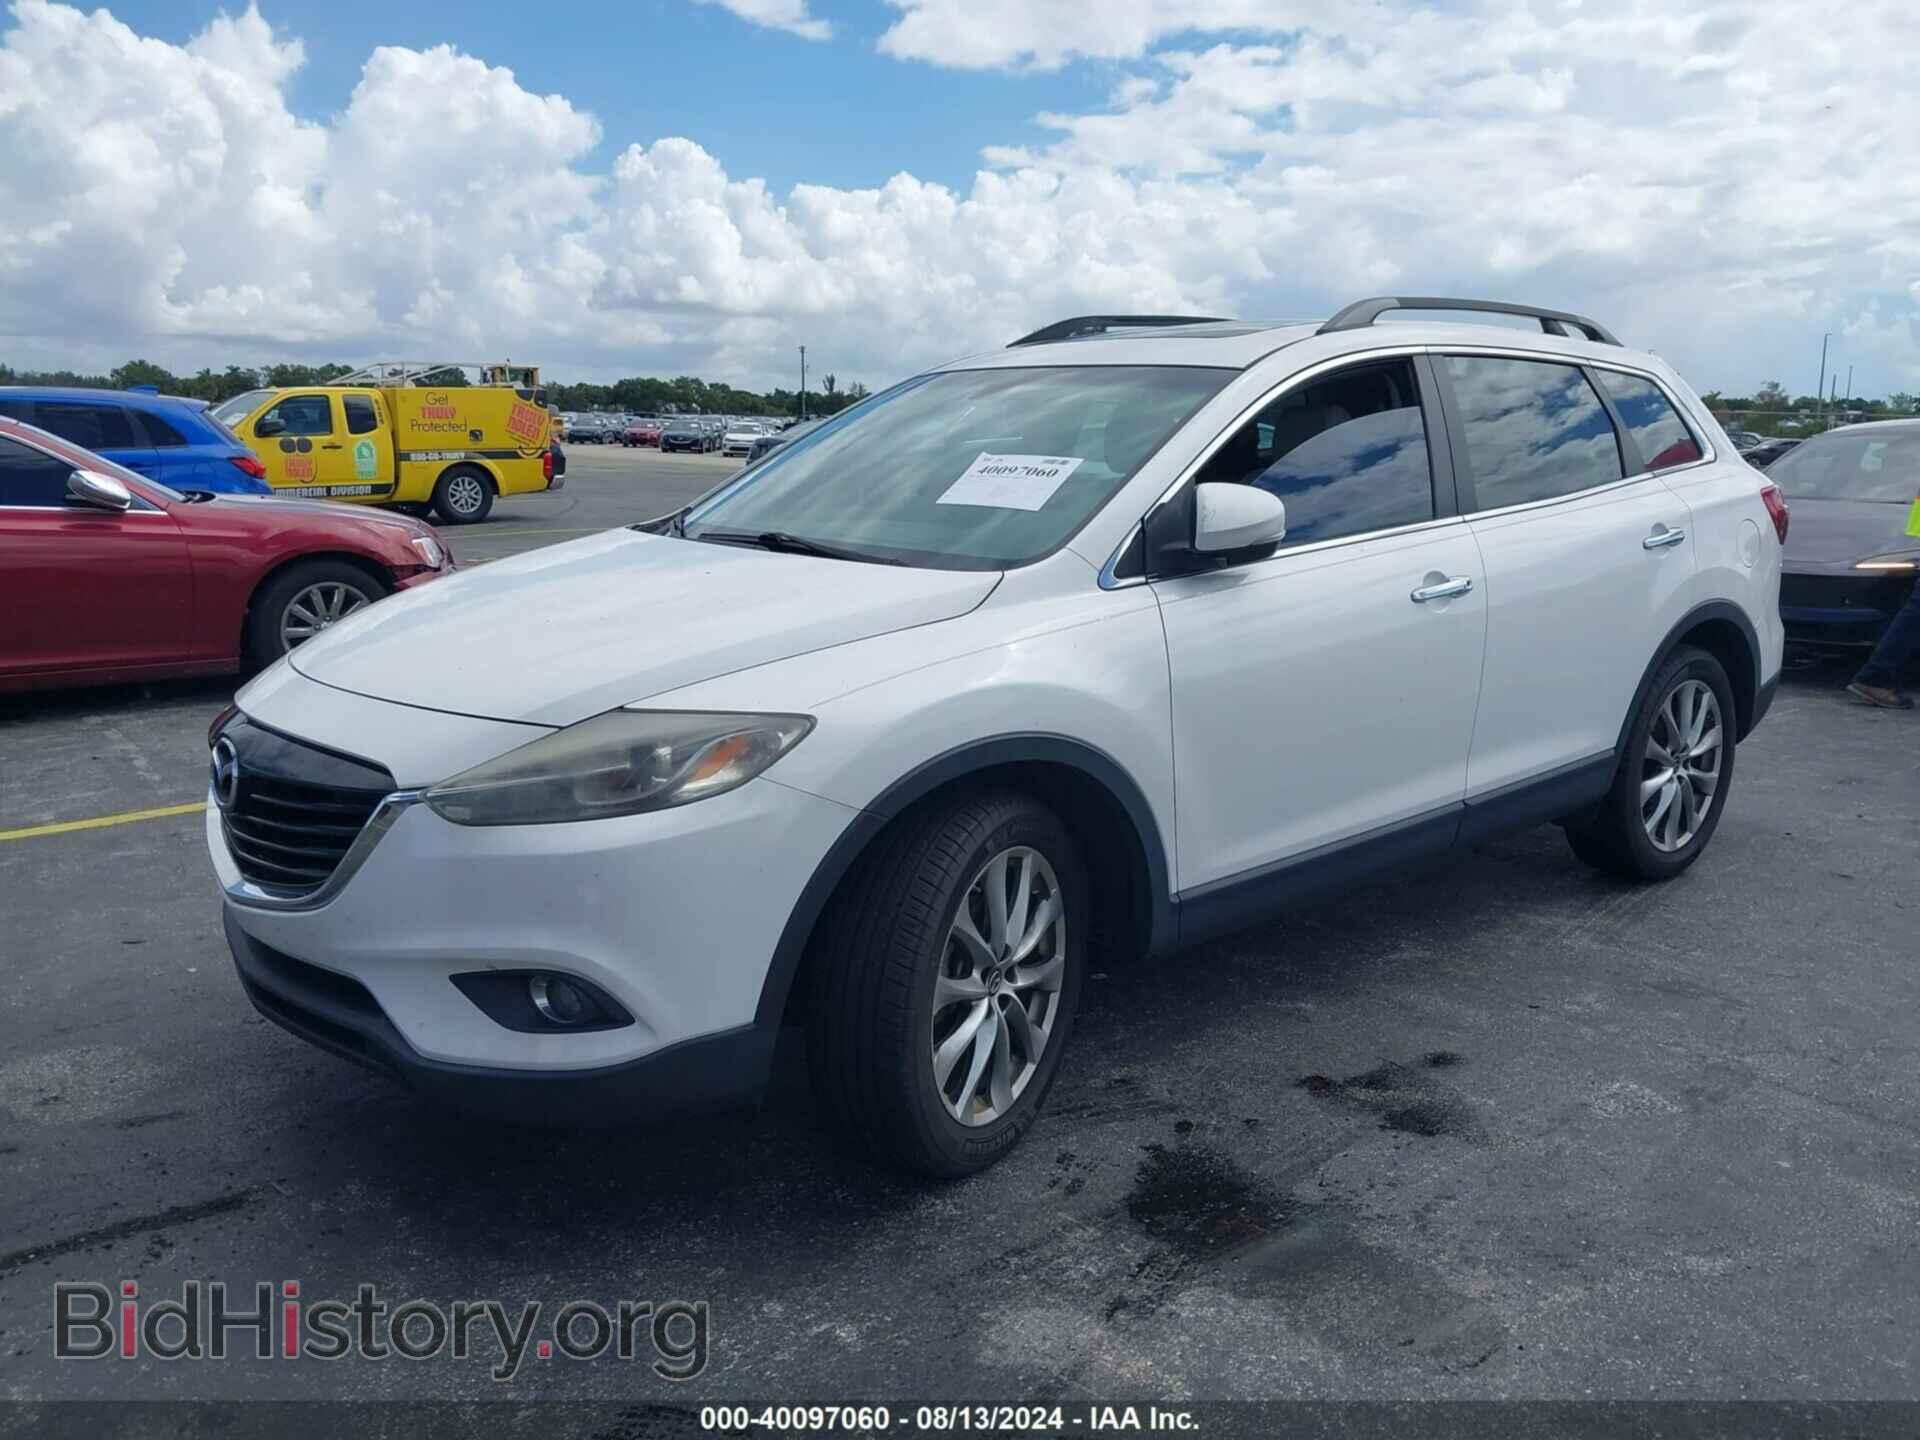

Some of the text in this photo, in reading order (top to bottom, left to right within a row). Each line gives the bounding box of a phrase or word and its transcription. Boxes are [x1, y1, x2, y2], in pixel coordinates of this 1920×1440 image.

[425, 391, 448, 405] Get
[410, 417, 467, 432] Protected
[977, 464, 1059, 479] 40097060
[274, 485, 372, 496] MMERCIAL DIVISION
